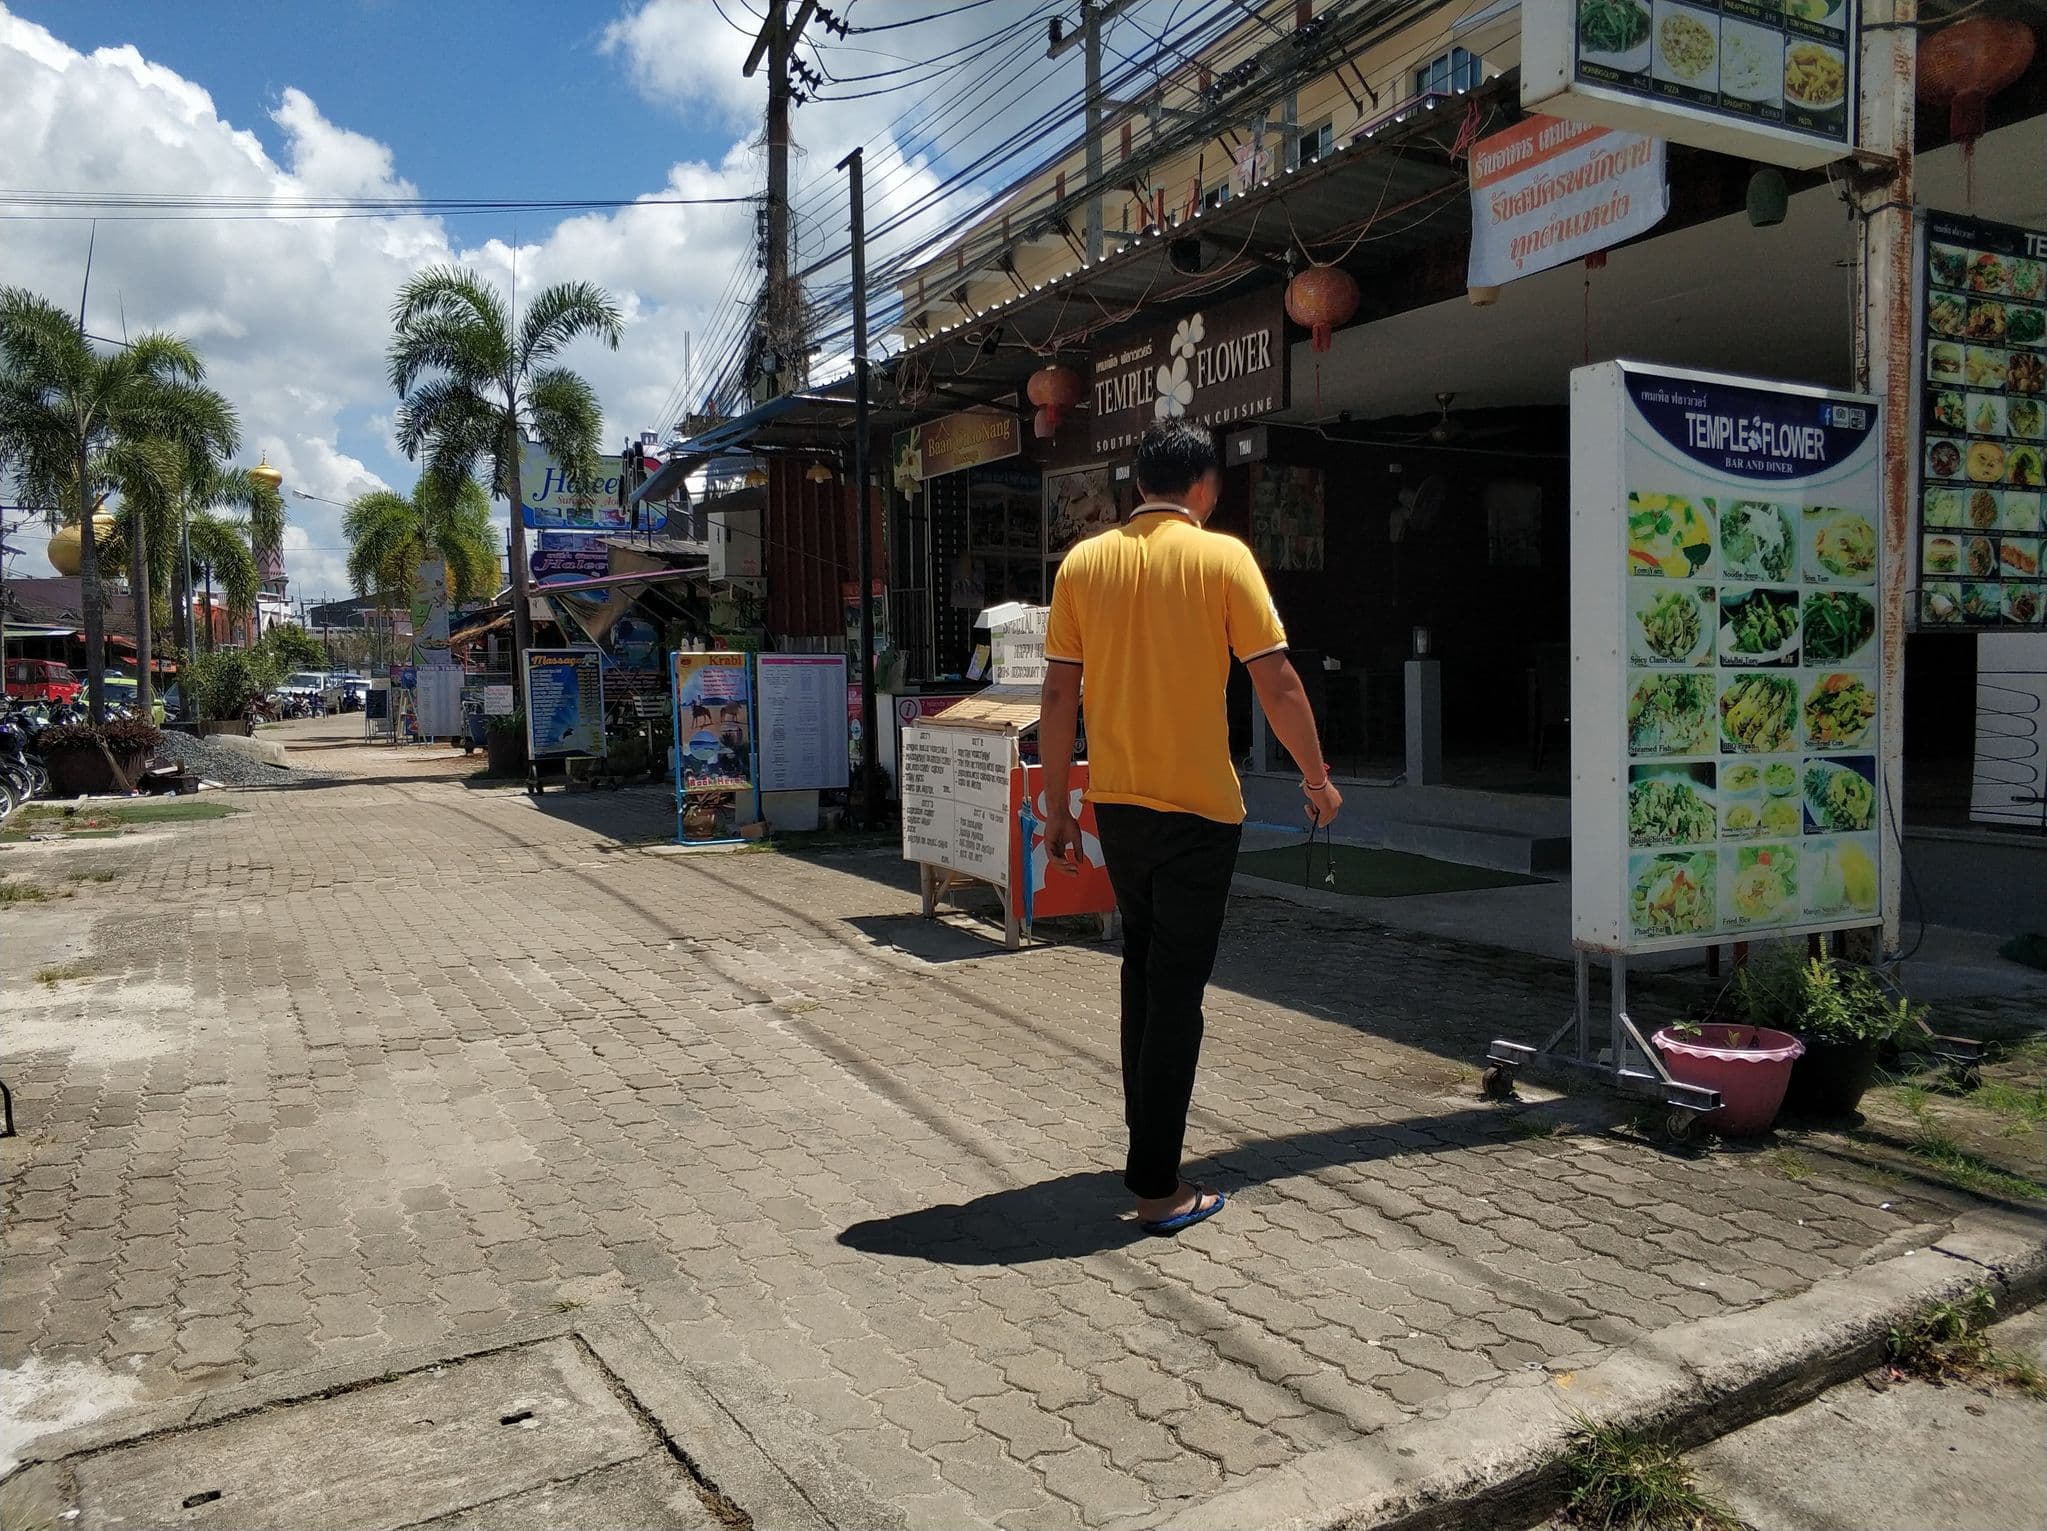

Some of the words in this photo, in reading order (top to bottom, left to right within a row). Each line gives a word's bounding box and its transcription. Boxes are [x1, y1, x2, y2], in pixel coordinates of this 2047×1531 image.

[2024, 232, 2047, 258] TE
[1095, 366, 1154, 416] TEMPLE
[1196, 329, 1271, 389] FLOWER
[1215, 396, 1272, 424] CUISINE
[1685, 412, 1750, 452] TEMPLE
[1761, 424, 1826, 462] FLOWER
[1725, 457, 1743, 469] BAR
[1745, 459, 1765, 471] AND
[1766, 461, 1793, 474] DINER
[1723, 569, 1742, 578] Noodle
[532, 655, 583, 667] Massage
[1630, 655, 1647, 665] Spicy
[1669, 656, 1686, 664] Salad
[1630, 744, 1657, 753] Steamed
[1659, 743, 1672, 752] Fish
[1723, 743, 1736, 751] BBQ
[1723, 917, 1737, 926] Fried
